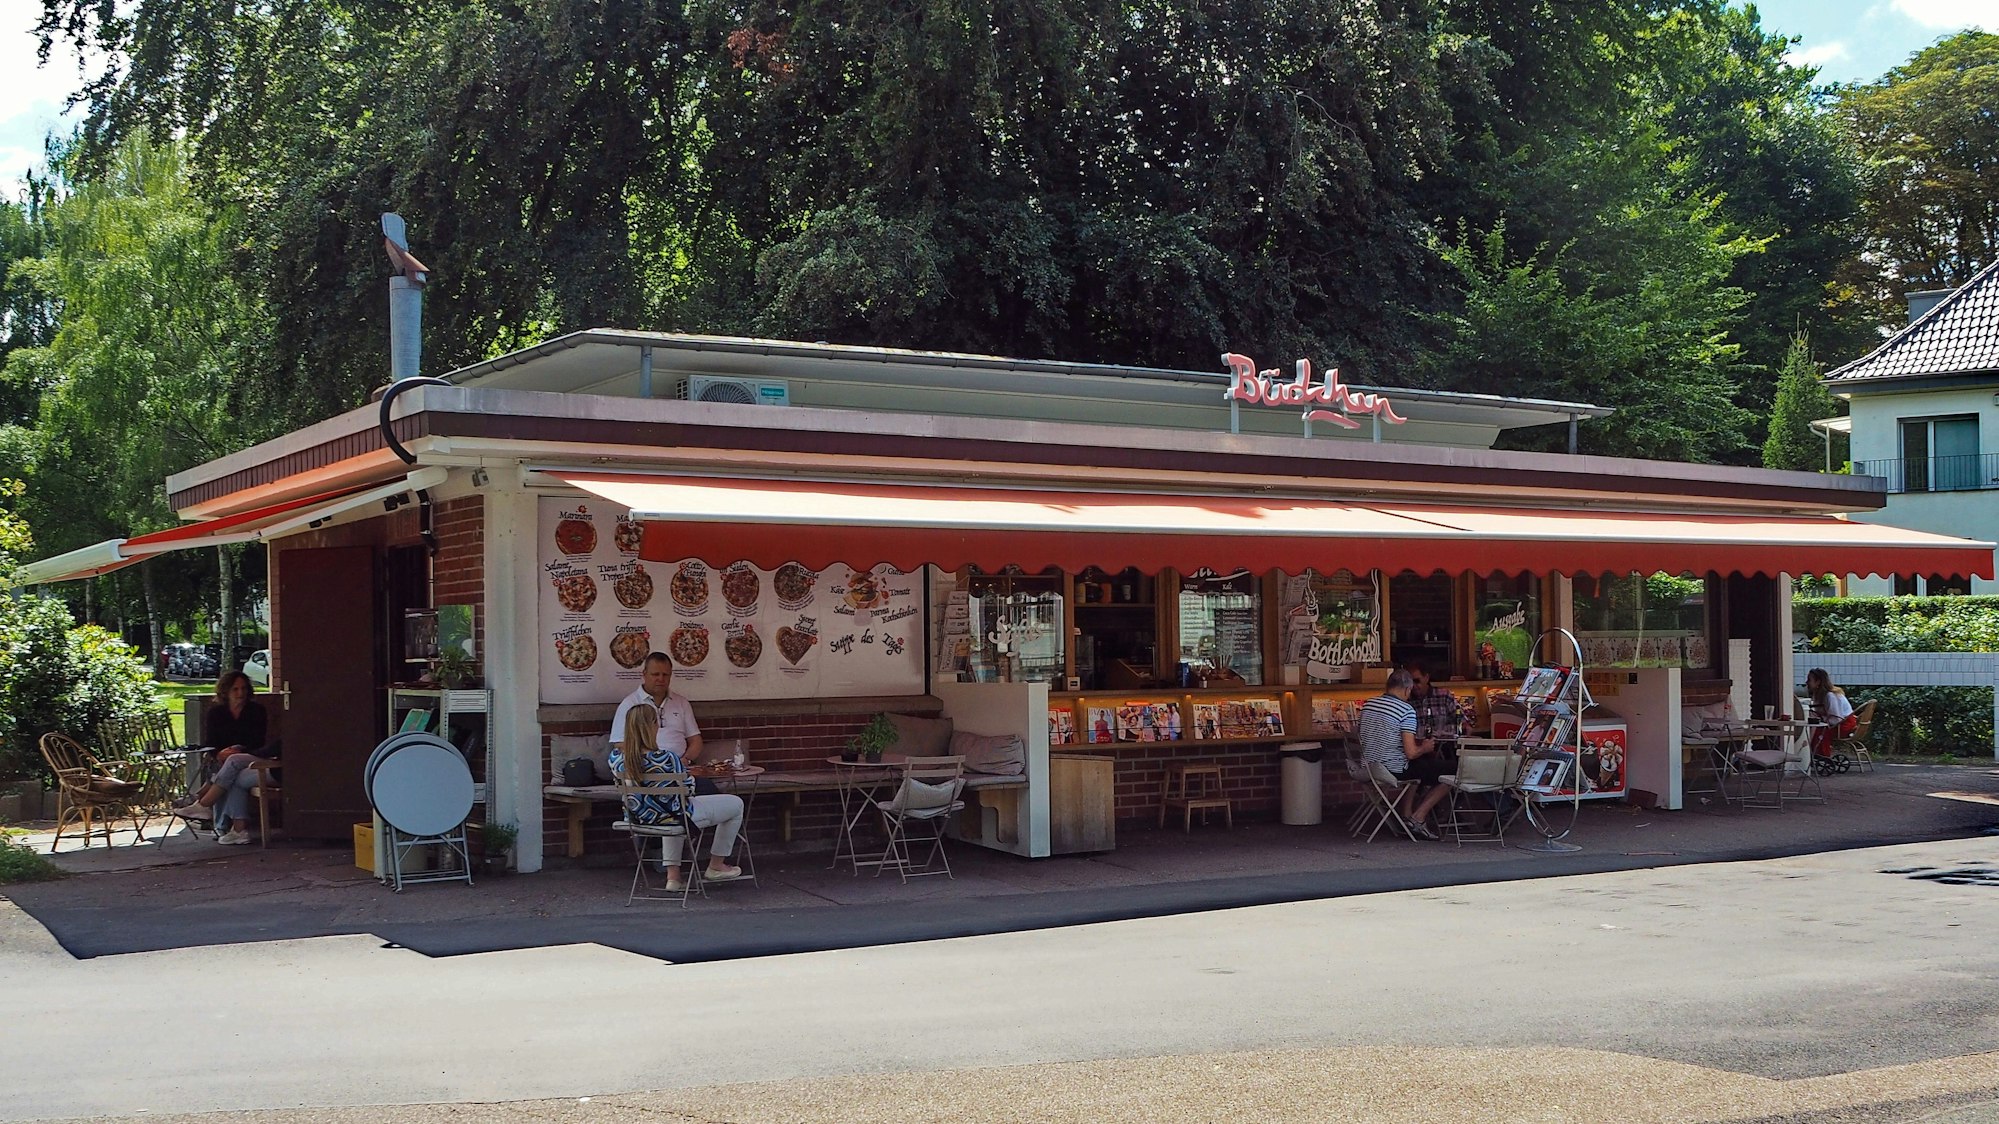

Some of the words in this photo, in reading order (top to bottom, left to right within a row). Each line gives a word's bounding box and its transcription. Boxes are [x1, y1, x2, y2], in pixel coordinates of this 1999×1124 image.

[1221, 352, 1408, 426] Büdchen
[559, 511, 593, 520] Marinara
[551, 566, 588, 581] Napoletana
[870, 607, 890, 618] Parma
[1485, 601, 1526, 637] Ausgabe
[615, 621, 647, 634] Carbonara
[721, 618, 741, 631] Garlic
[552, 623, 592, 643] Trüffelchen
[829, 633, 856, 656] Suppe
[860, 628, 875, 644] des
